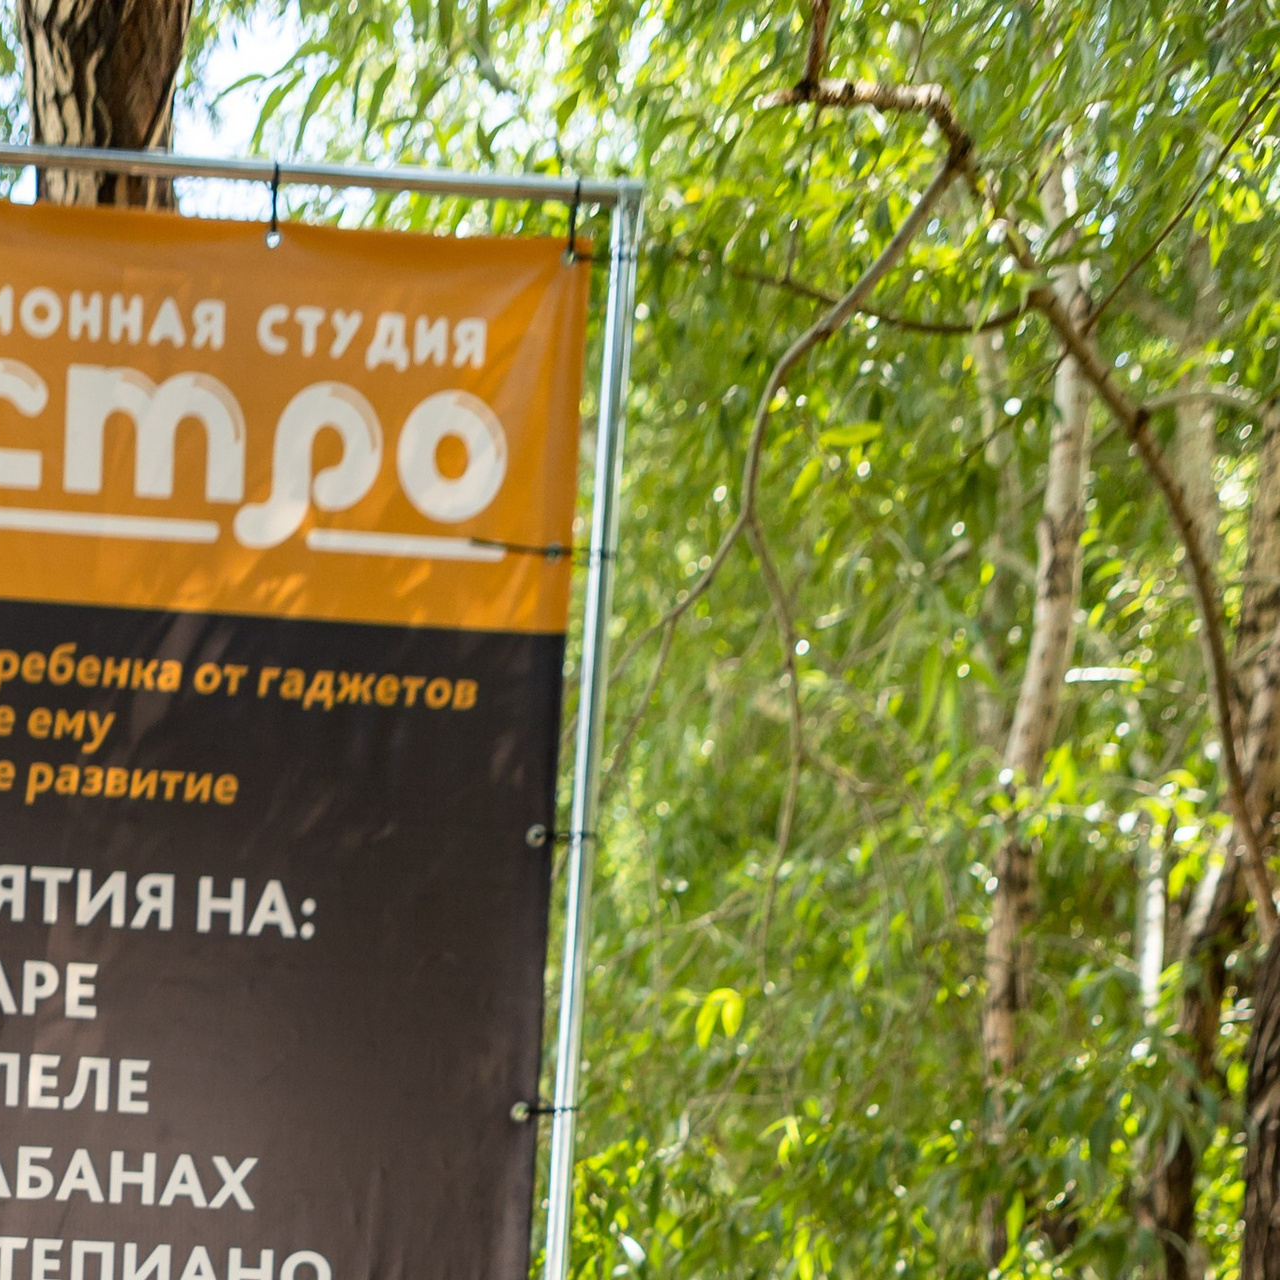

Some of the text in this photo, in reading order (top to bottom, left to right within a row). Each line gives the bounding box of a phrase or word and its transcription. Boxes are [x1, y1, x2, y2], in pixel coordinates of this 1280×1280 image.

[257, 304, 487, 371] СТУДИЯ
[193, 662, 247, 694] от
[258, 667, 477, 710] гаджетов
[27, 708, 115, 754] ему
[25, 762, 238, 804] развитие
[197, 876, 317, 939] НА:
